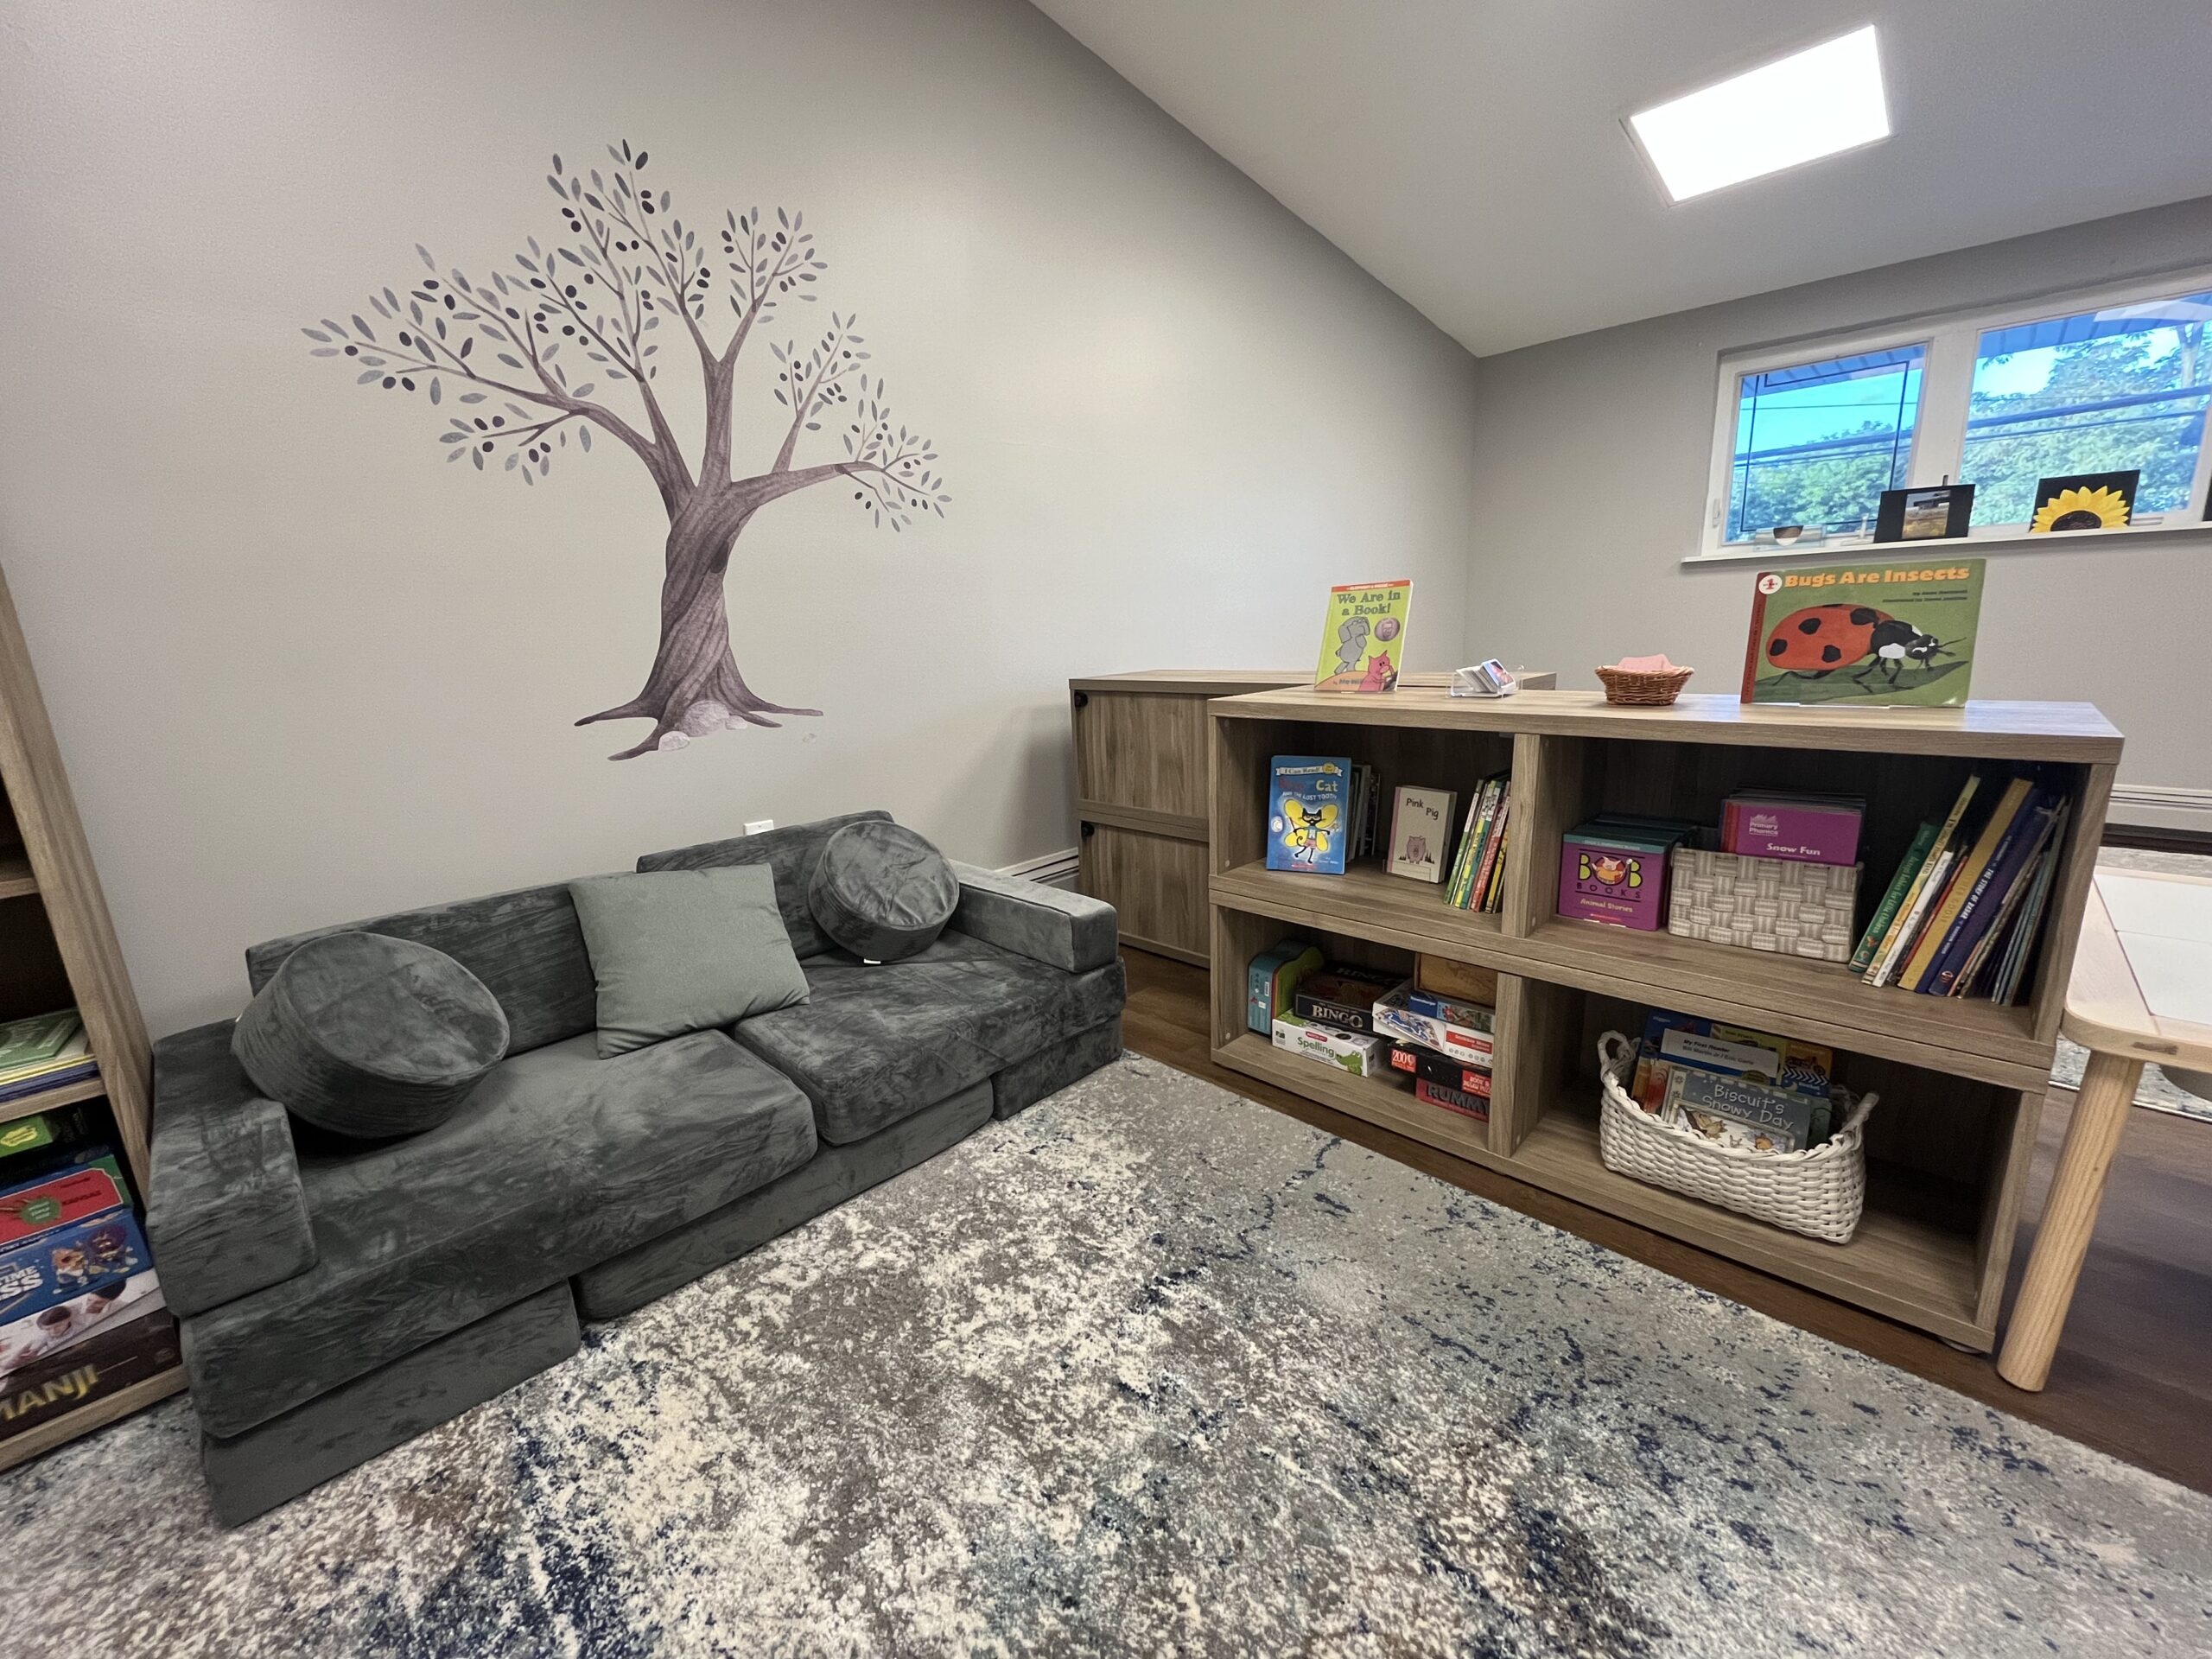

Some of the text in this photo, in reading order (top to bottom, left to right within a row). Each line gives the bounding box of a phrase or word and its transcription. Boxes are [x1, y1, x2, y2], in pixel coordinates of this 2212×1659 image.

[1784, 566, 1970, 588] Bugs Are Insects
[1337, 590, 1401, 603] We Are in
[1354, 603, 1391, 615] Book!
[1316, 779, 1338, 792] Cat
[1406, 798, 1424, 808] Pink
[1426, 807, 1439, 820] Pig
[1766, 843, 1821, 855] Snow Fun
[1578, 853, 1643, 888] BOB
[1983, 868, 1993, 879] THE
[1577, 882, 1641, 899] BOOKS
[1974, 878, 1987, 895] STORY
[1969, 893, 1979, 902] OF
[1580, 899, 1633, 912] Animal Stories
[1313, 1005, 1363, 1028] BINGO
[1298, 1037, 1334, 1058] Spelling
[1714, 1084, 1785, 1115] Biscuit's
[1702, 1095, 1794, 1131] Snowy Day
